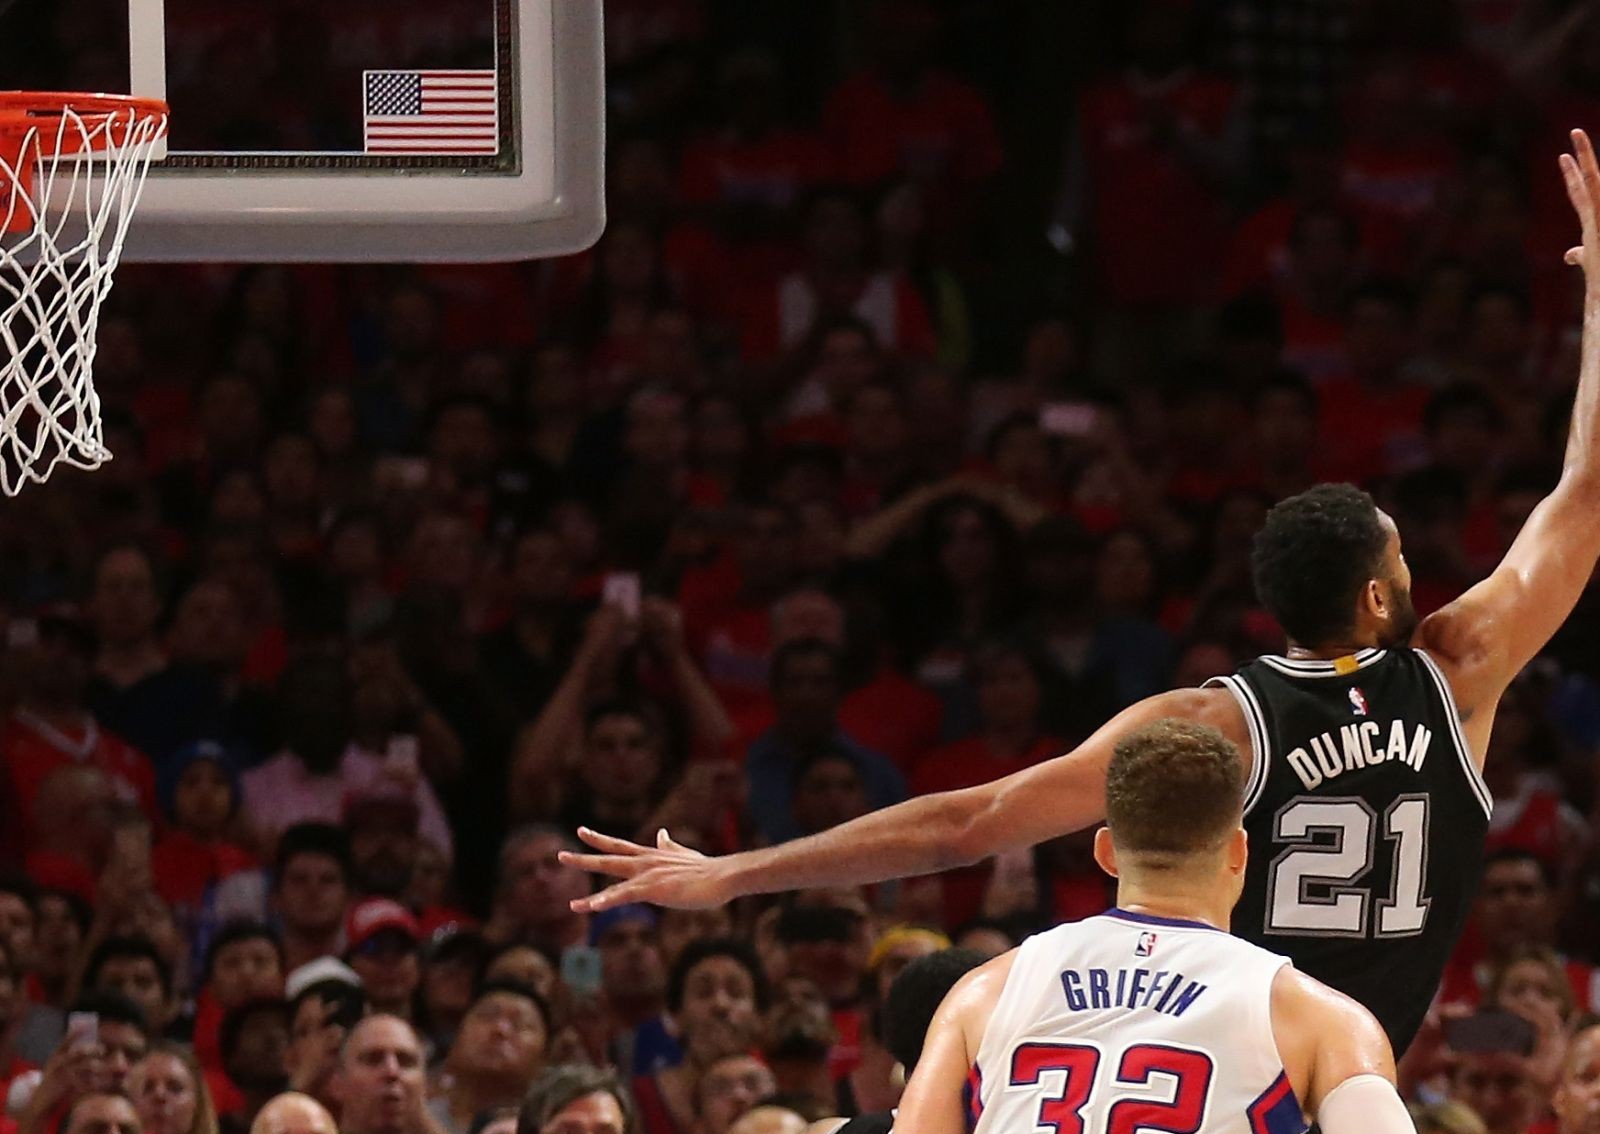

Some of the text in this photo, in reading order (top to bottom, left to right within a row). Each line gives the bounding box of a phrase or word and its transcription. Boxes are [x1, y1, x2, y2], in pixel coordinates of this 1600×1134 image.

[1286, 719, 1432, 791] DUNCAN
[1264, 793, 1432, 939] 21
[1061, 968, 1207, 1017] GRIFFIN
